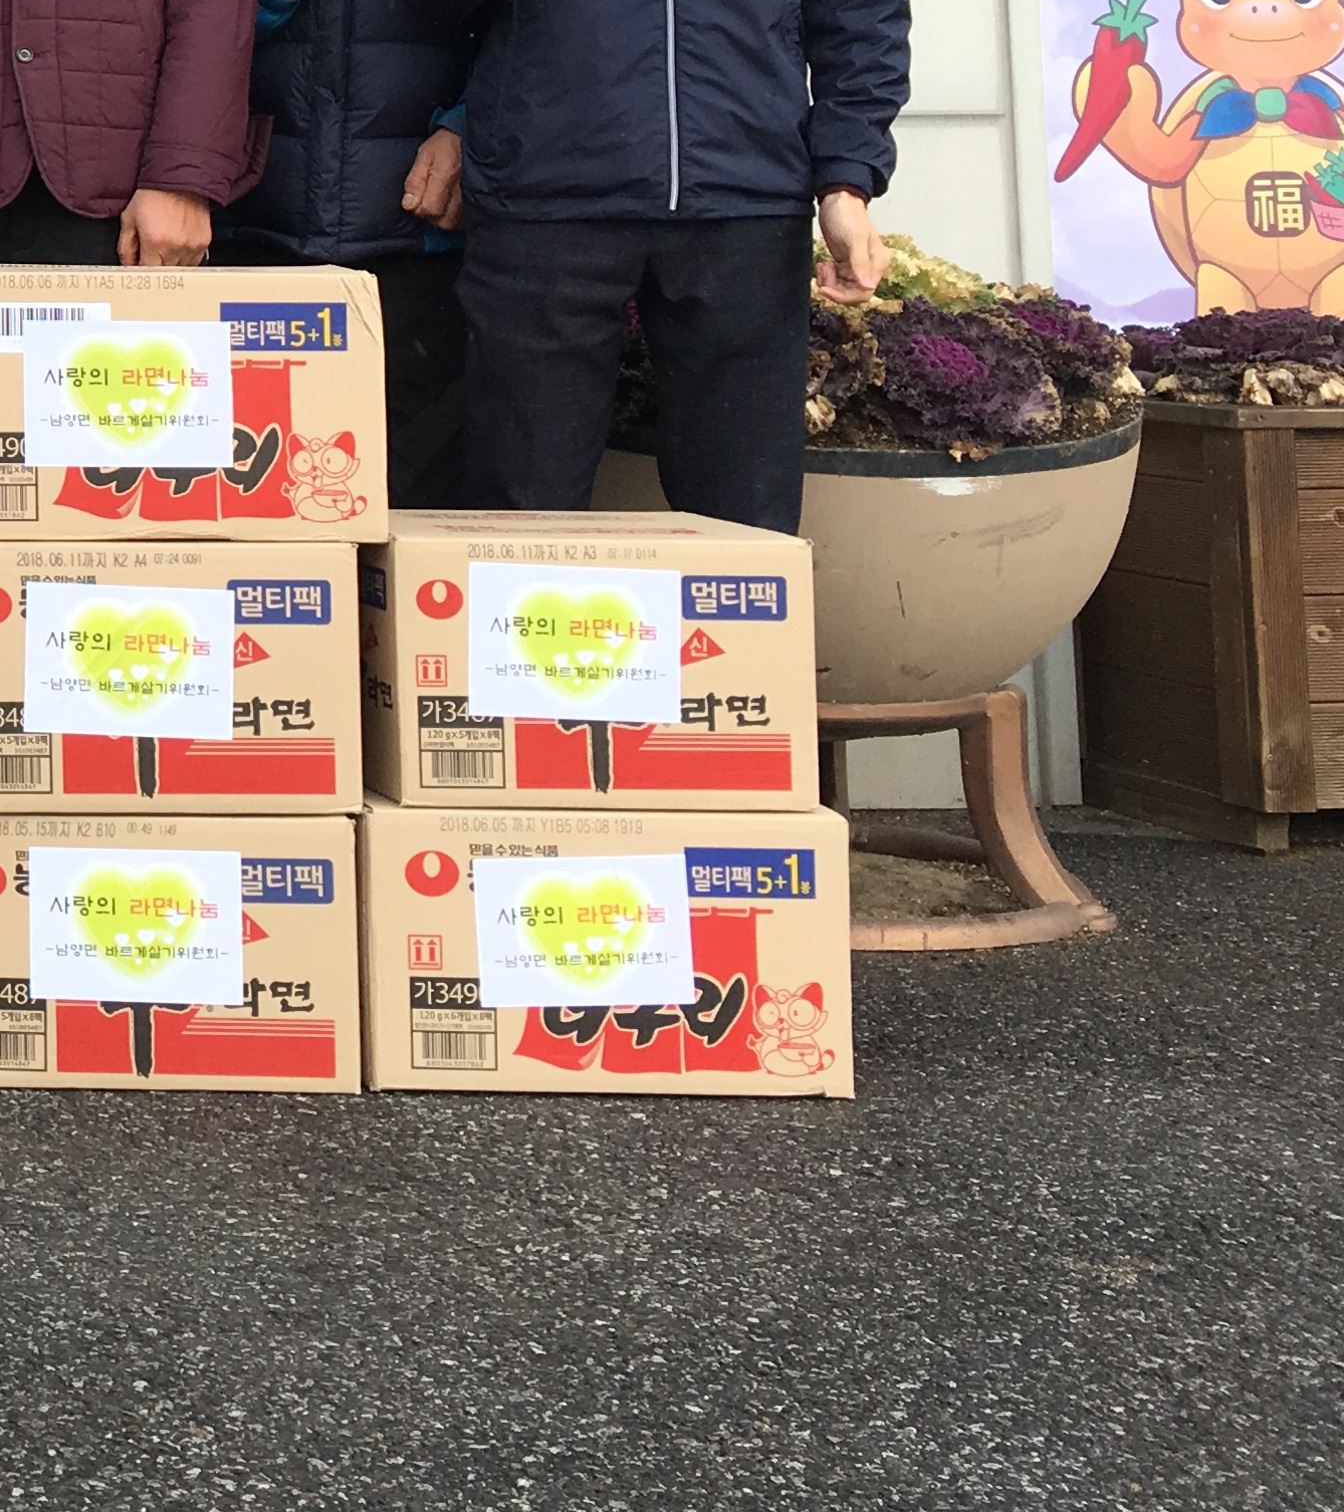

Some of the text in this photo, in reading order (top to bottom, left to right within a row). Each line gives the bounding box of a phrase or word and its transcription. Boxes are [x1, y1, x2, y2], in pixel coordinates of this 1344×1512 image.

[1252, 178, 1305, 231] 福
[229, 320, 286, 346] 멀티팩
[44, 368, 209, 387] 사랑의 라면나눔
[236, 586, 322, 618] 멀티팩
[691, 582, 778, 614] 멀티팩
[490, 616, 658, 640] 사랑의 라면나눔
[46, 632, 210, 656] 사랑의 라면나눔
[236, 641, 252, 661] 신
[690, 637, 708, 656] 신
[233, 697, 314, 735] 라면
[681, 692, 771, 728] 라면
[242, 864, 323, 898] 멀티팩
[692, 866, 752, 893] 멀티팩
[50, 896, 218, 919] 사랑의 라면나눔
[497, 905, 666, 925] 사랑의 라면나눔
